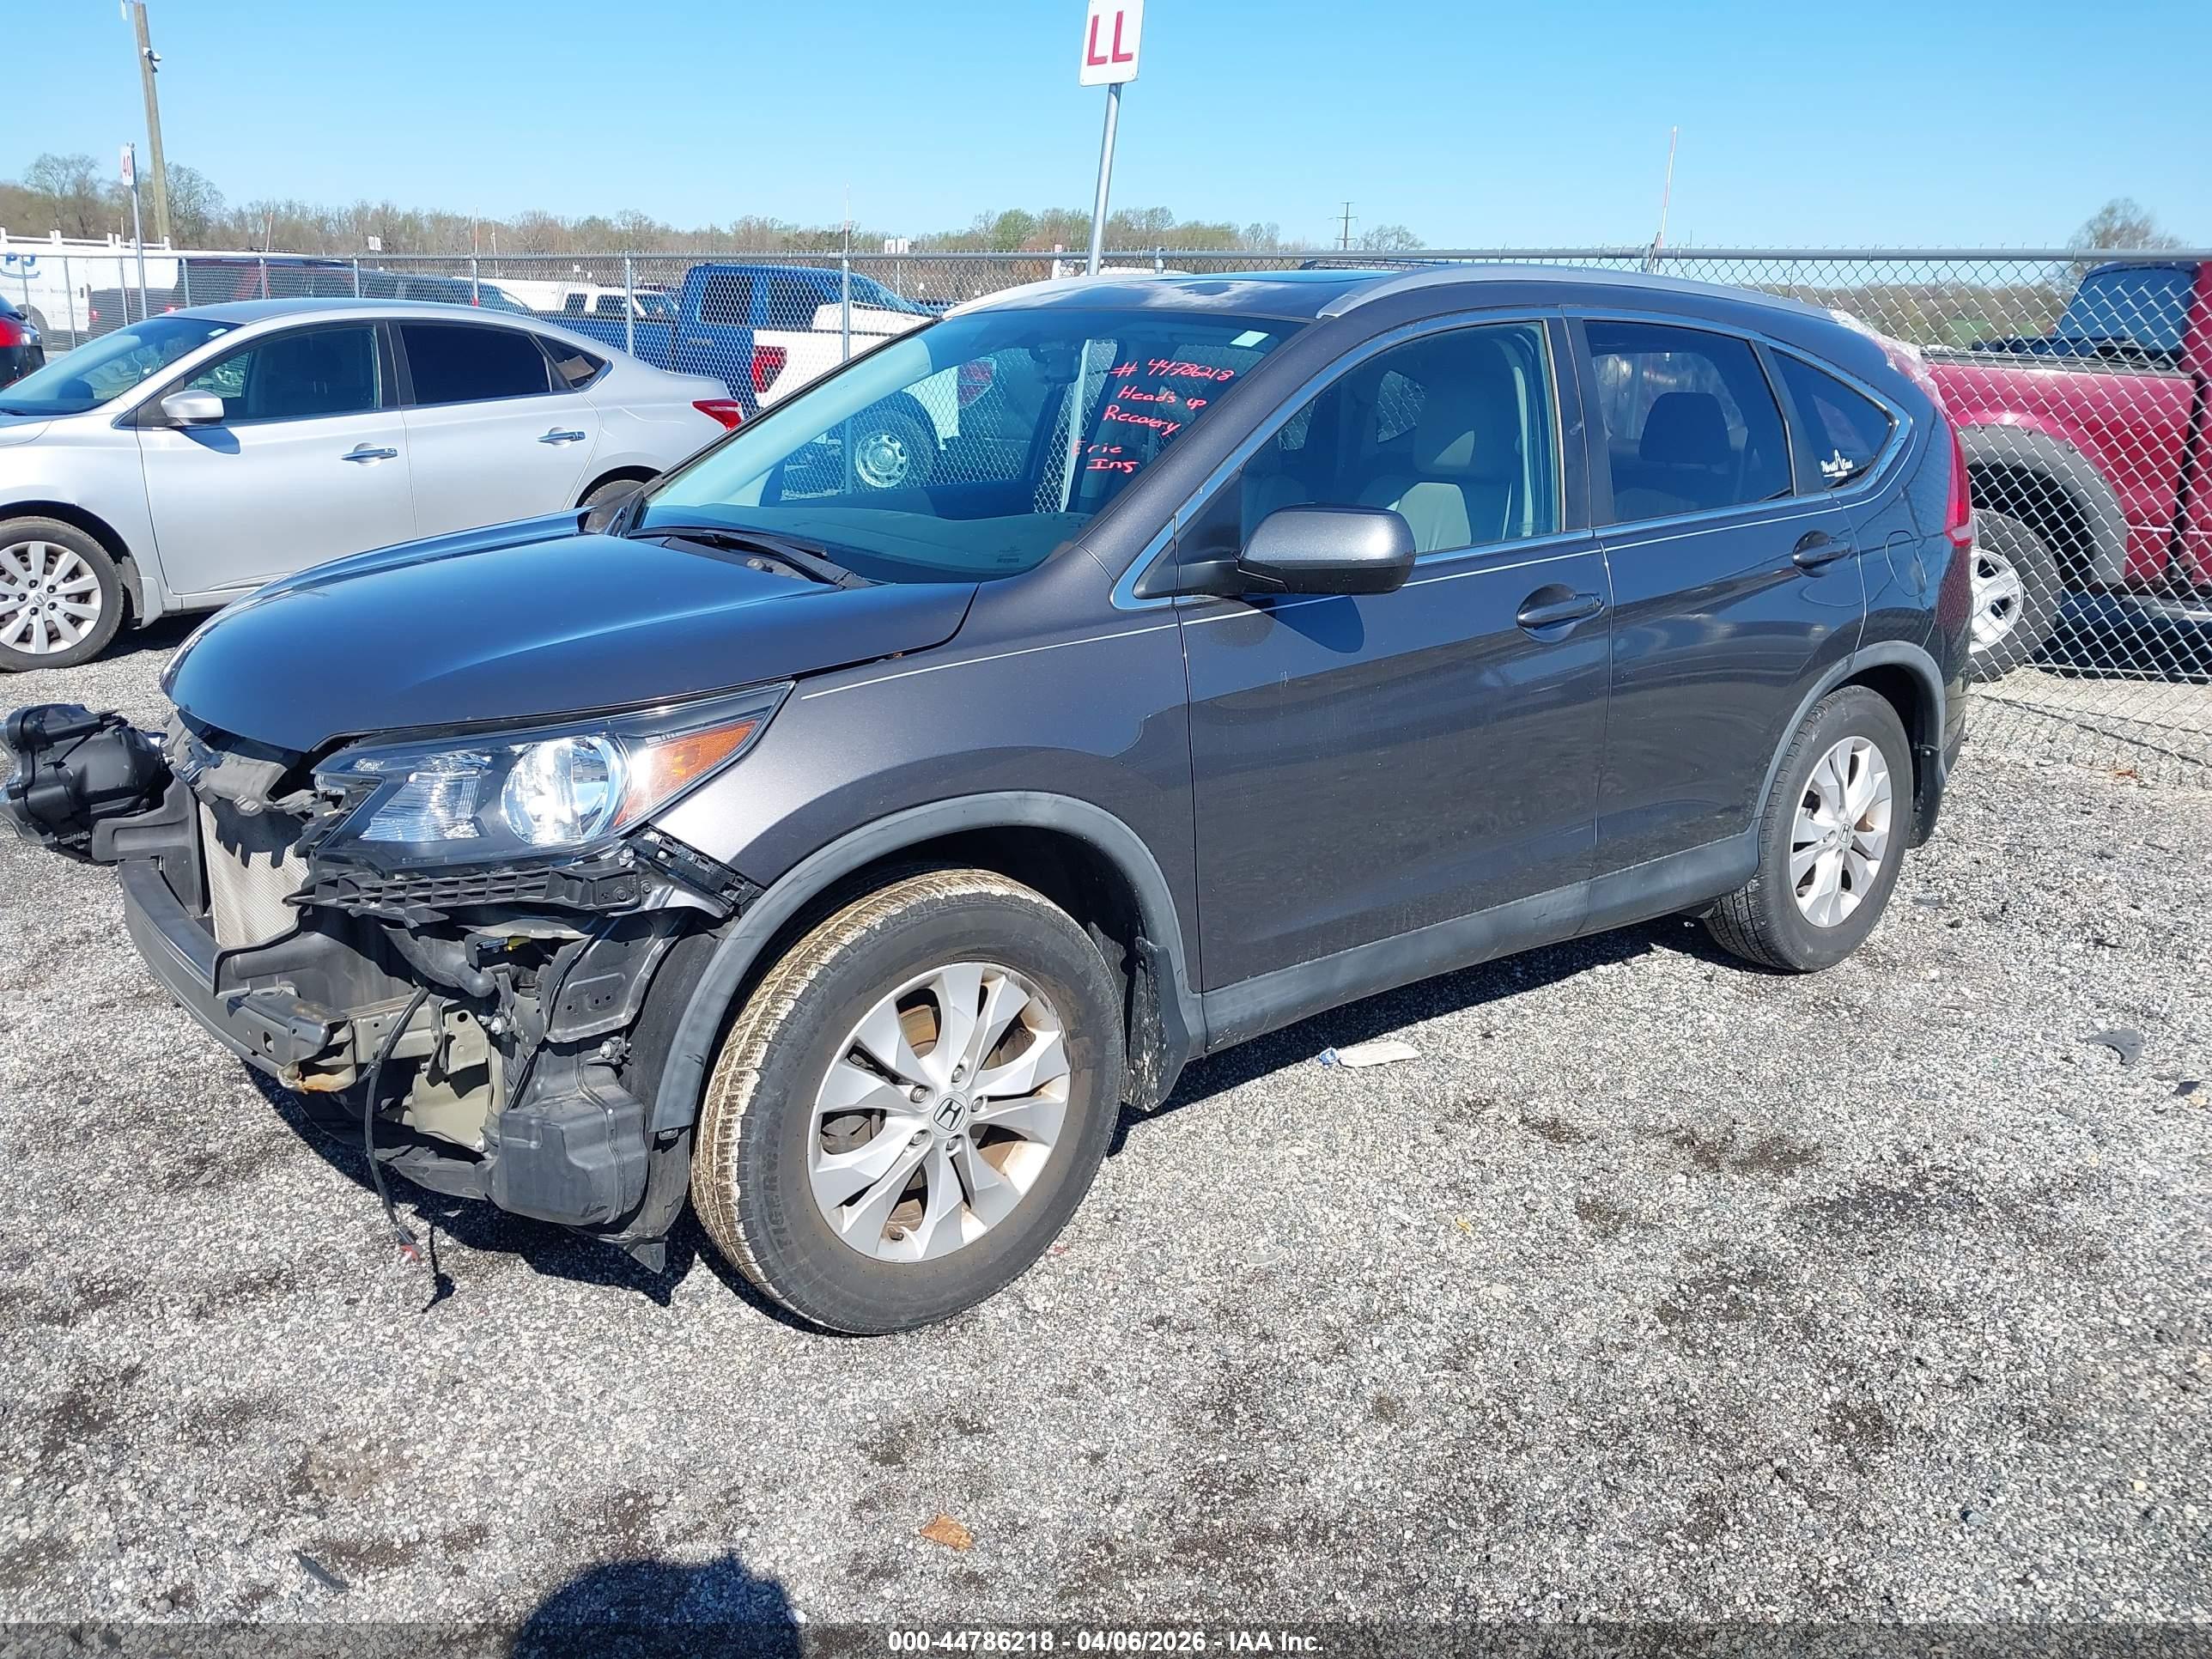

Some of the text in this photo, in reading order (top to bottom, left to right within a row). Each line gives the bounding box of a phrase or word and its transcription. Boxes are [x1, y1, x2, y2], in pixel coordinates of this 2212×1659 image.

[1086, 10, 1133, 66] LL
[122, 155, 132, 177] 40
[1147, 358, 1235, 381] 44786218
[1186, 398, 1207, 410] up
[1103, 404, 1182, 436] Recovery
